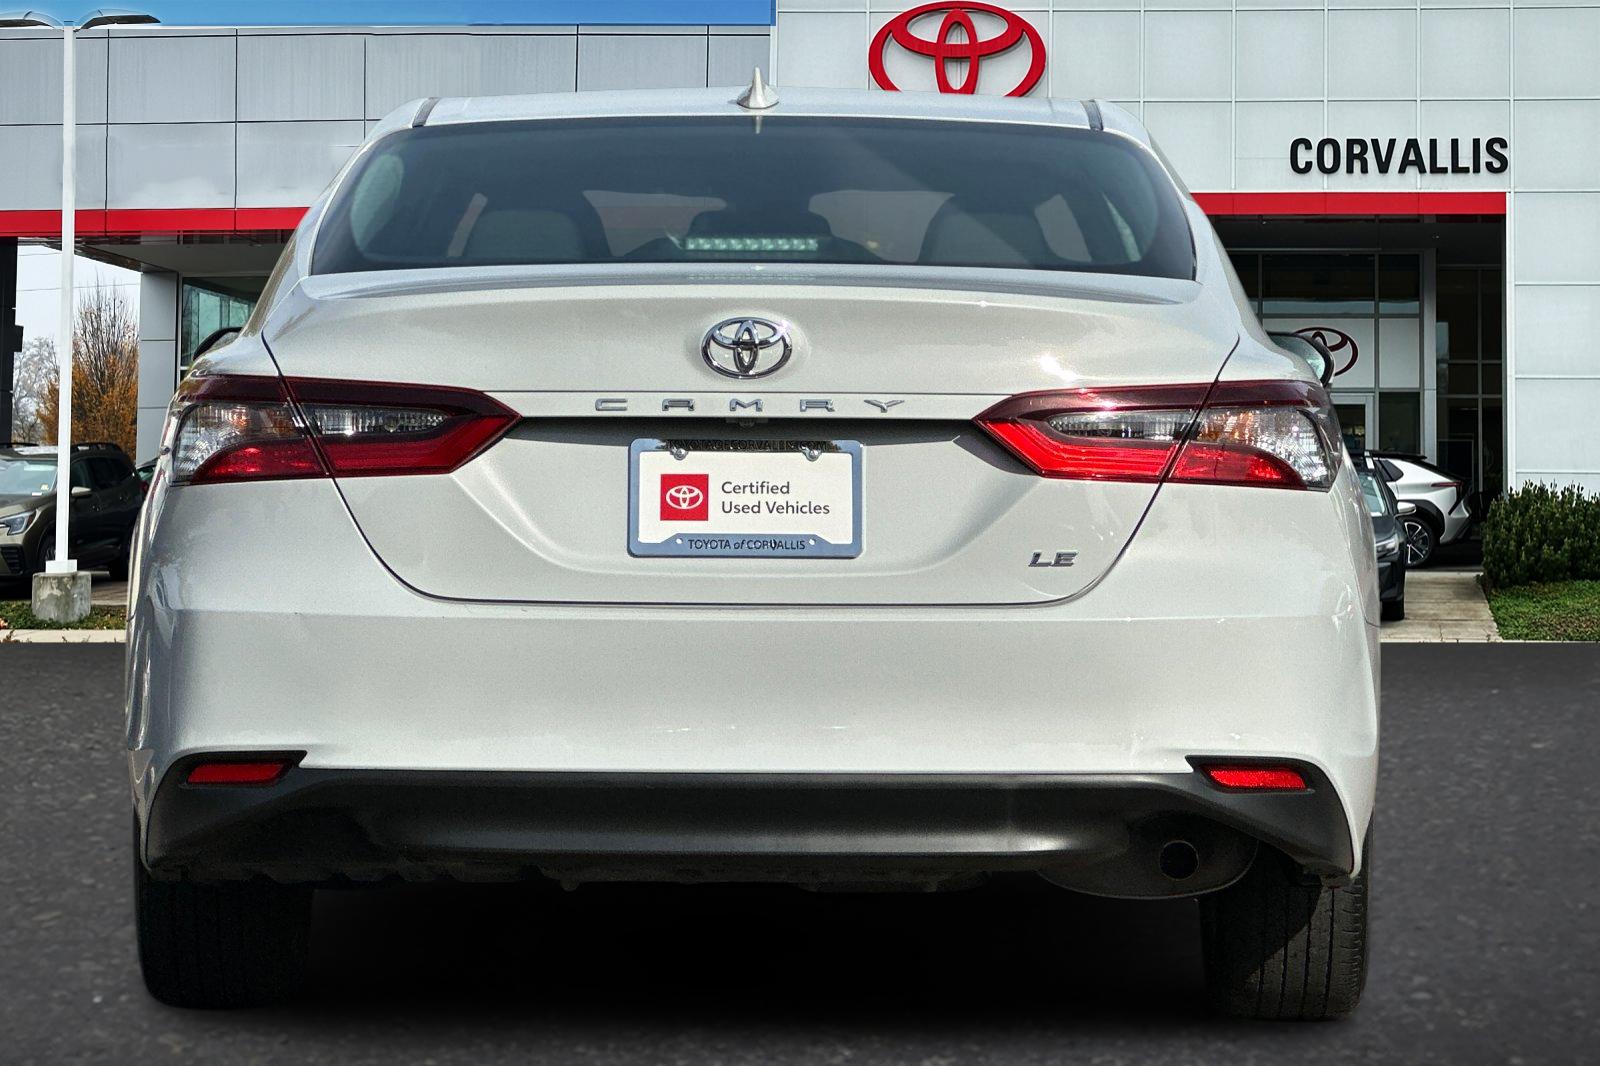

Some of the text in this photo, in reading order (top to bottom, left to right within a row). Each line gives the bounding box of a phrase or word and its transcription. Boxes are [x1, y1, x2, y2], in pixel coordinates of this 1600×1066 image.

[1290, 137, 1509, 175] CORVALLIS
[594, 397, 905, 414] CAMRY
[721, 481, 790, 495] Certified
[721, 501, 830, 515] Used Vehicles
[688, 539, 806, 551] TOYOTA of CORVALLIS
[1028, 550, 1078, 568] LE
